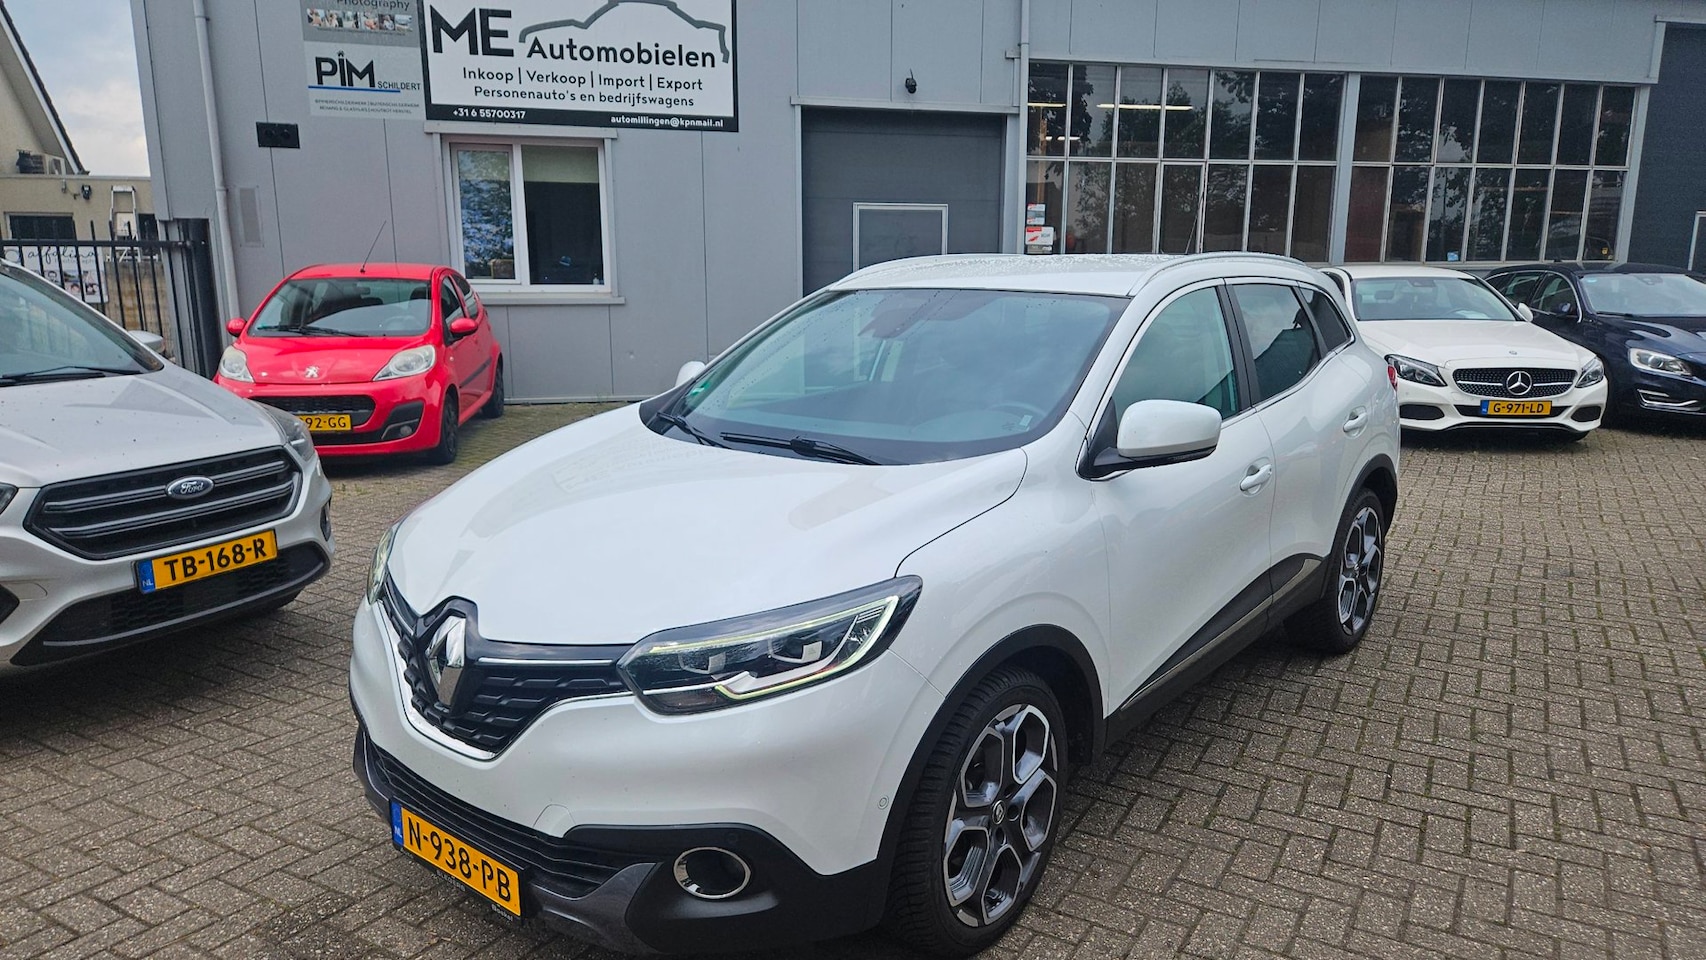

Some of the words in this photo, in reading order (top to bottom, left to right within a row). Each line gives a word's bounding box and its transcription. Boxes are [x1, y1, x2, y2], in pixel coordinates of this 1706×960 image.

[430, 4, 515, 57] ME
[527, 36, 716, 69] Automobielen
[377, 81, 421, 91] SCHILDERT
[463, 67, 514, 84] Inkoop
[526, 70, 587, 87] Verkoop
[599, 74, 645, 90] Import
[657, 77, 703, 92] Export
[474, 86, 576, 101] Personenauto's
[580, 94, 595, 102] en
[599, 92, 695, 109] bedrijfswagens
[453, 107, 469, 117] +31
[471, 108, 478, 117] 6
[480, 108, 526, 119] 55700317
[610, 115, 723, 128] automillingen@kpnmail.nl
[1493, 403, 1544, 413] G-971-LD
[300, 416, 346, 428] 92-GG
[180, 481, 204, 494] Ford
[164, 538, 267, 581] TB-168-R
[408, 816, 511, 902] N-938-PB
